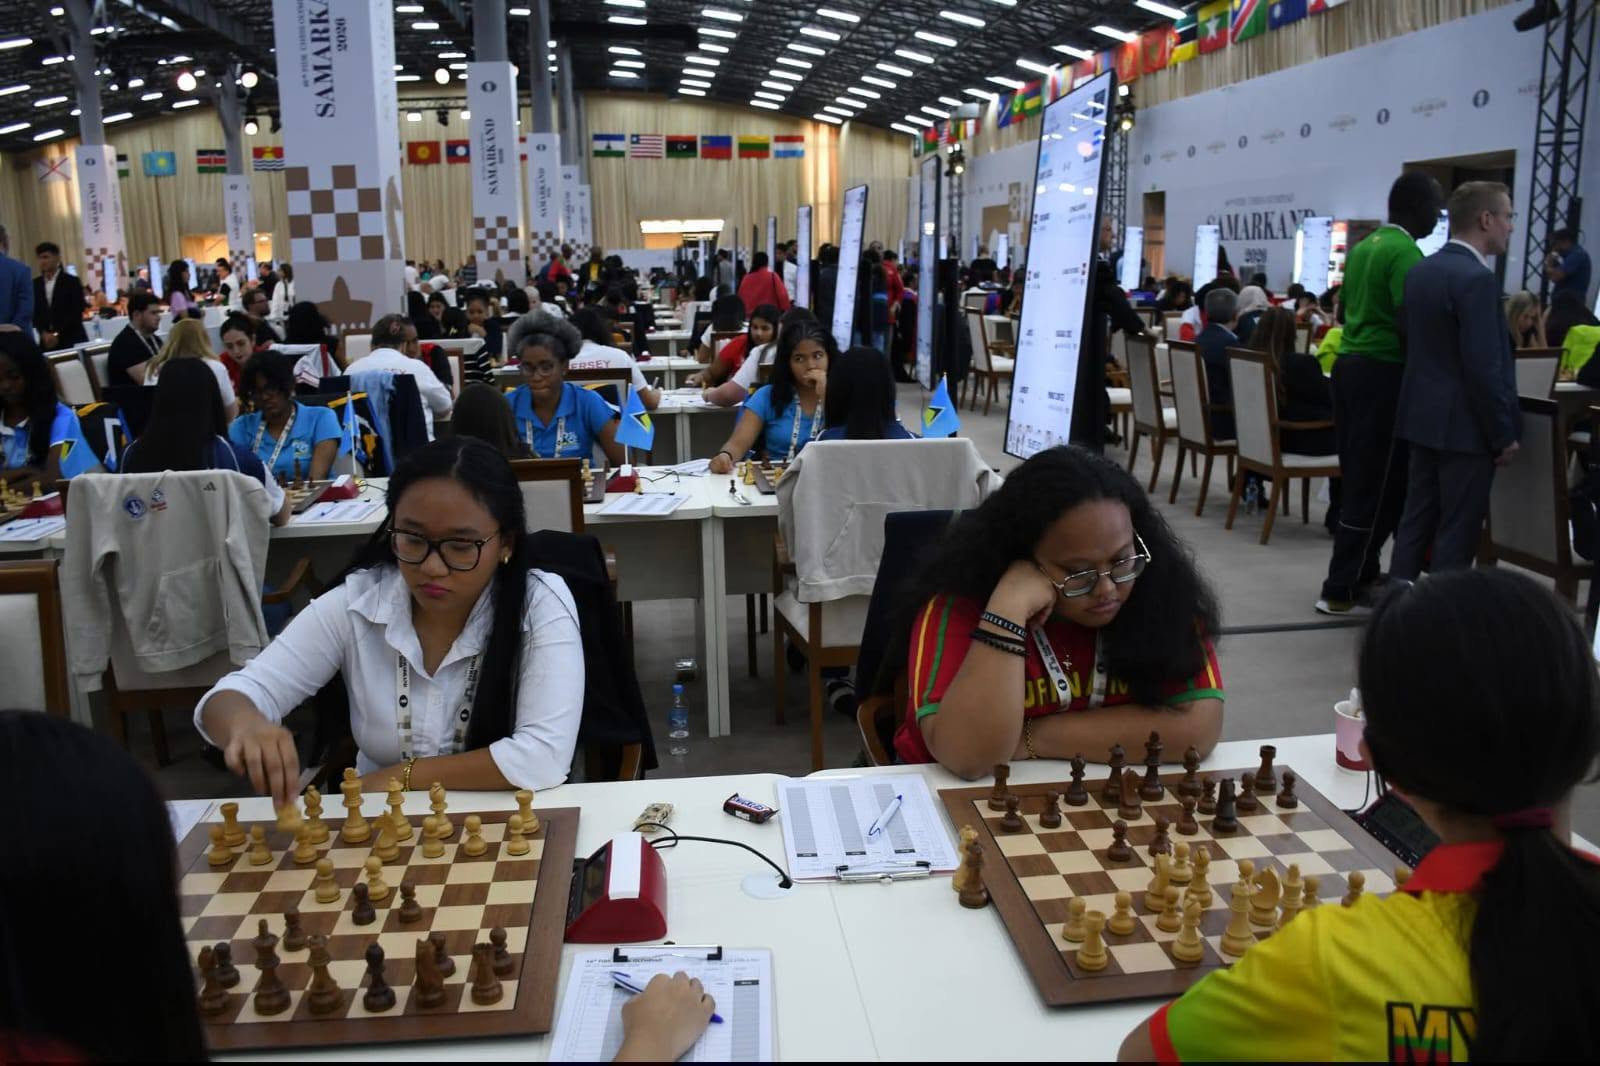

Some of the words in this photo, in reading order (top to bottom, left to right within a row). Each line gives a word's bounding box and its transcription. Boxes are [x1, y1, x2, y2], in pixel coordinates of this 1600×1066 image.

[335, 17, 348, 52] 2026
[485, 118, 498, 195] SAMARKAND
[571, 360, 611, 369] ERSEY
